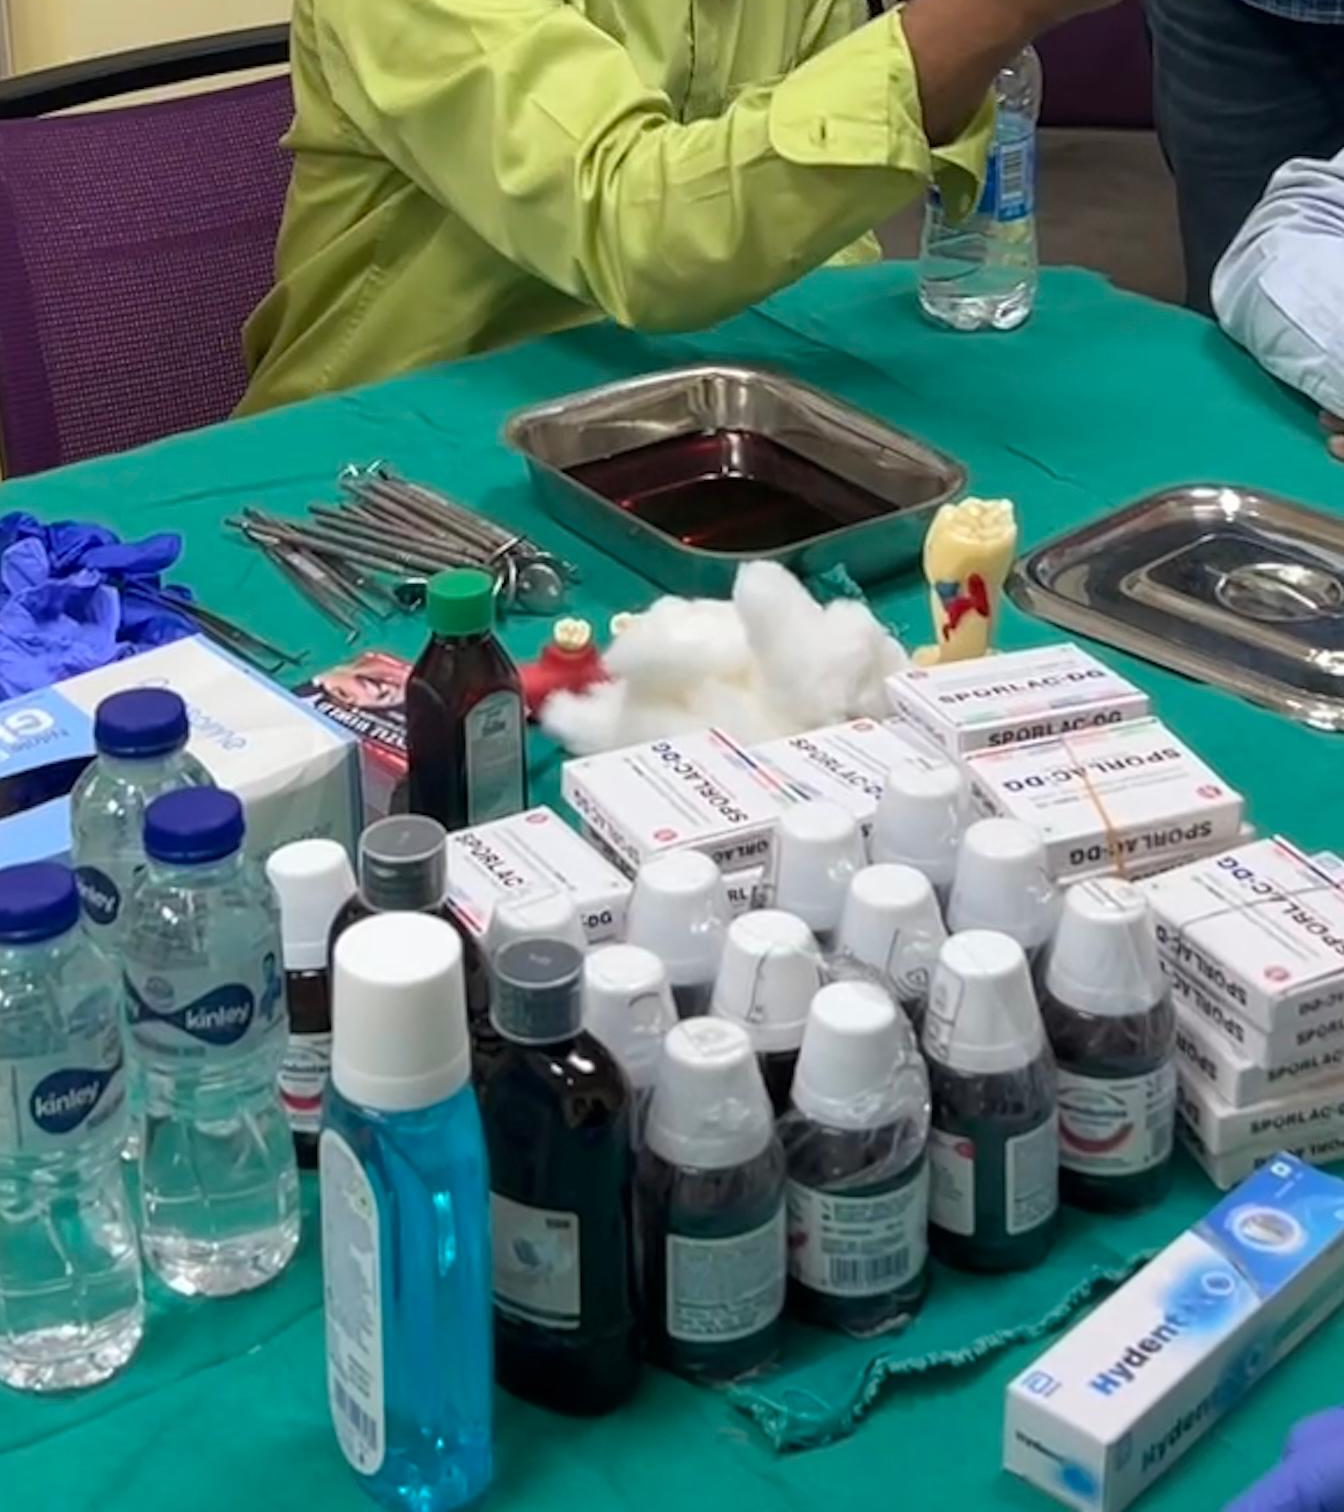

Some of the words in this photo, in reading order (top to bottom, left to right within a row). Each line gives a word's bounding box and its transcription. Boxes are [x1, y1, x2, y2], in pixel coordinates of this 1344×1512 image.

[938, 668, 1105, 704] SPORLAC-DG
[988, 711, 1123, 747] SPORLAC-DG
[651, 741, 749, 824] SPORLAC-DG
[1003, 747, 1182, 793] SPORLAC-DG
[185, 999, 252, 1031] kinley
[34, 1082, 101, 1119] kinley
